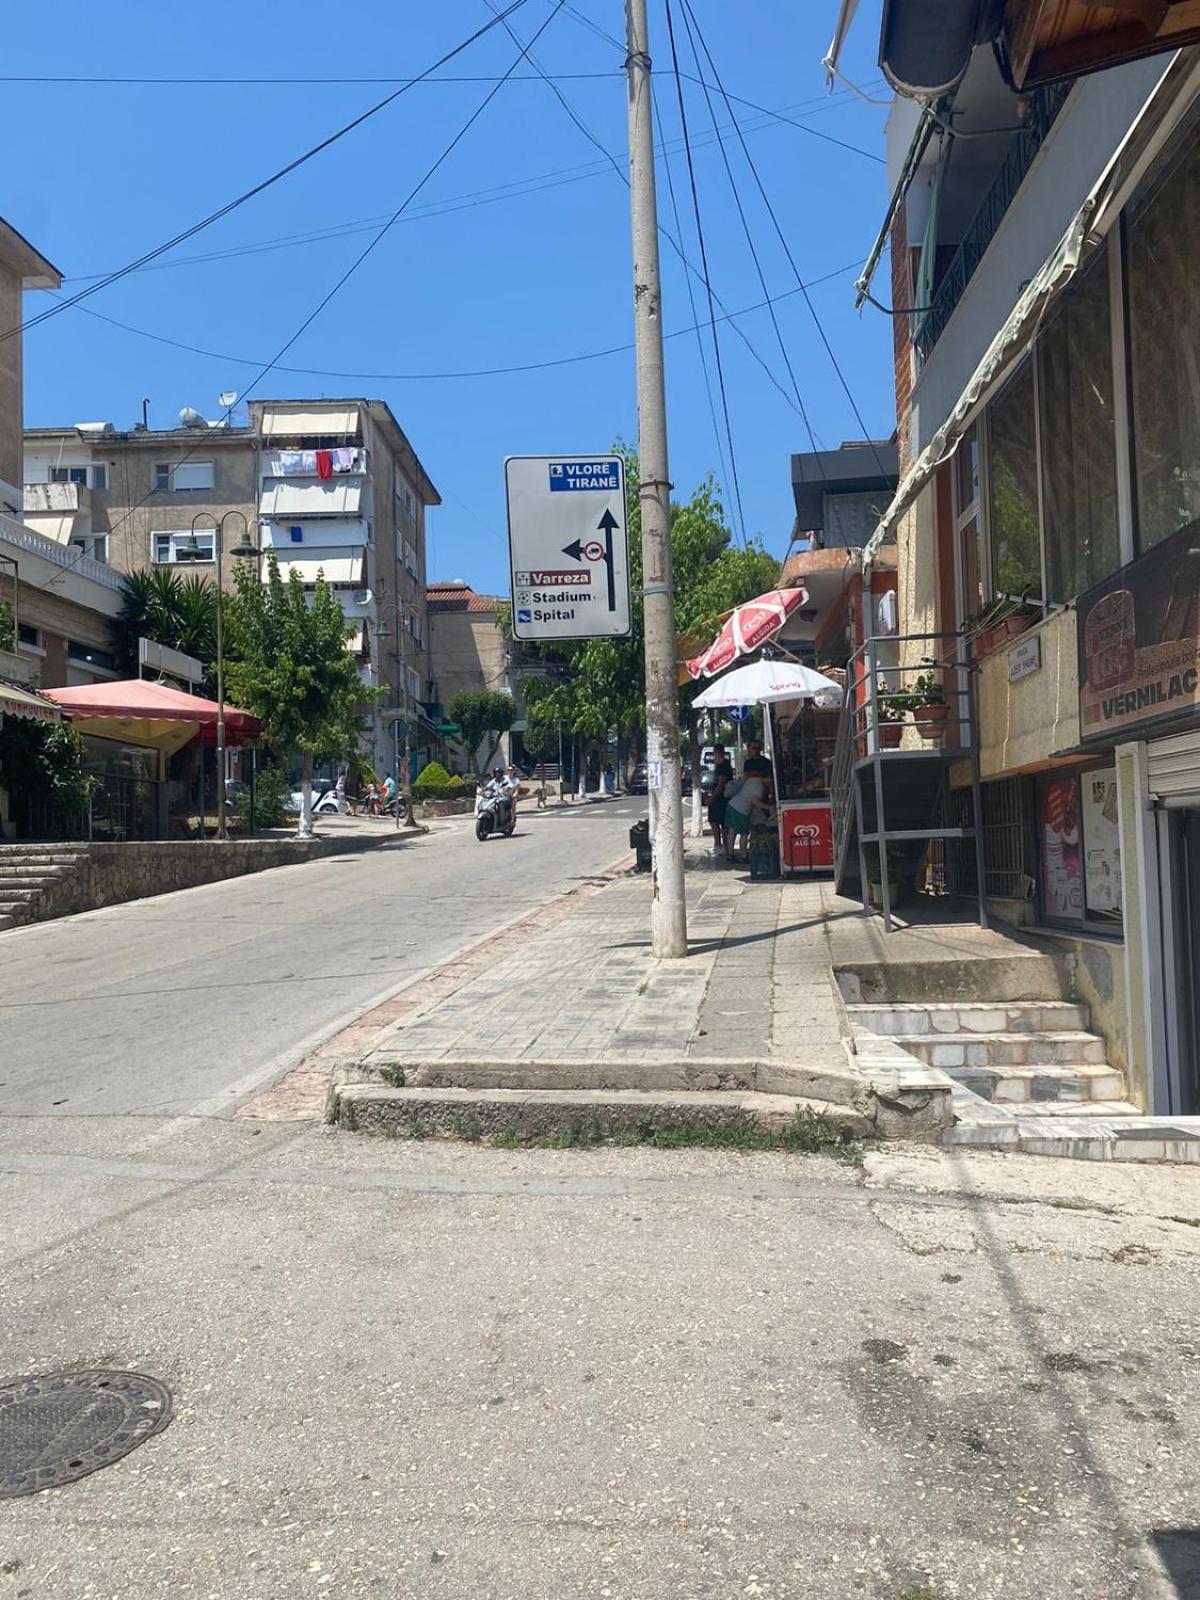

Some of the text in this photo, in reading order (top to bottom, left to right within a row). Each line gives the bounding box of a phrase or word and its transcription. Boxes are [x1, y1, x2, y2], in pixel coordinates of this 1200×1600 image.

[566, 462, 610, 475] VLORË
[567, 475, 617, 488] TIRANË
[532, 573, 589, 585] Varreza
[532, 592, 591, 603] Stadium
[534, 609, 575, 623] Spital
[752, 622, 775, 644] ALGIDA
[1102, 668, 1198, 720] VERNILAC
